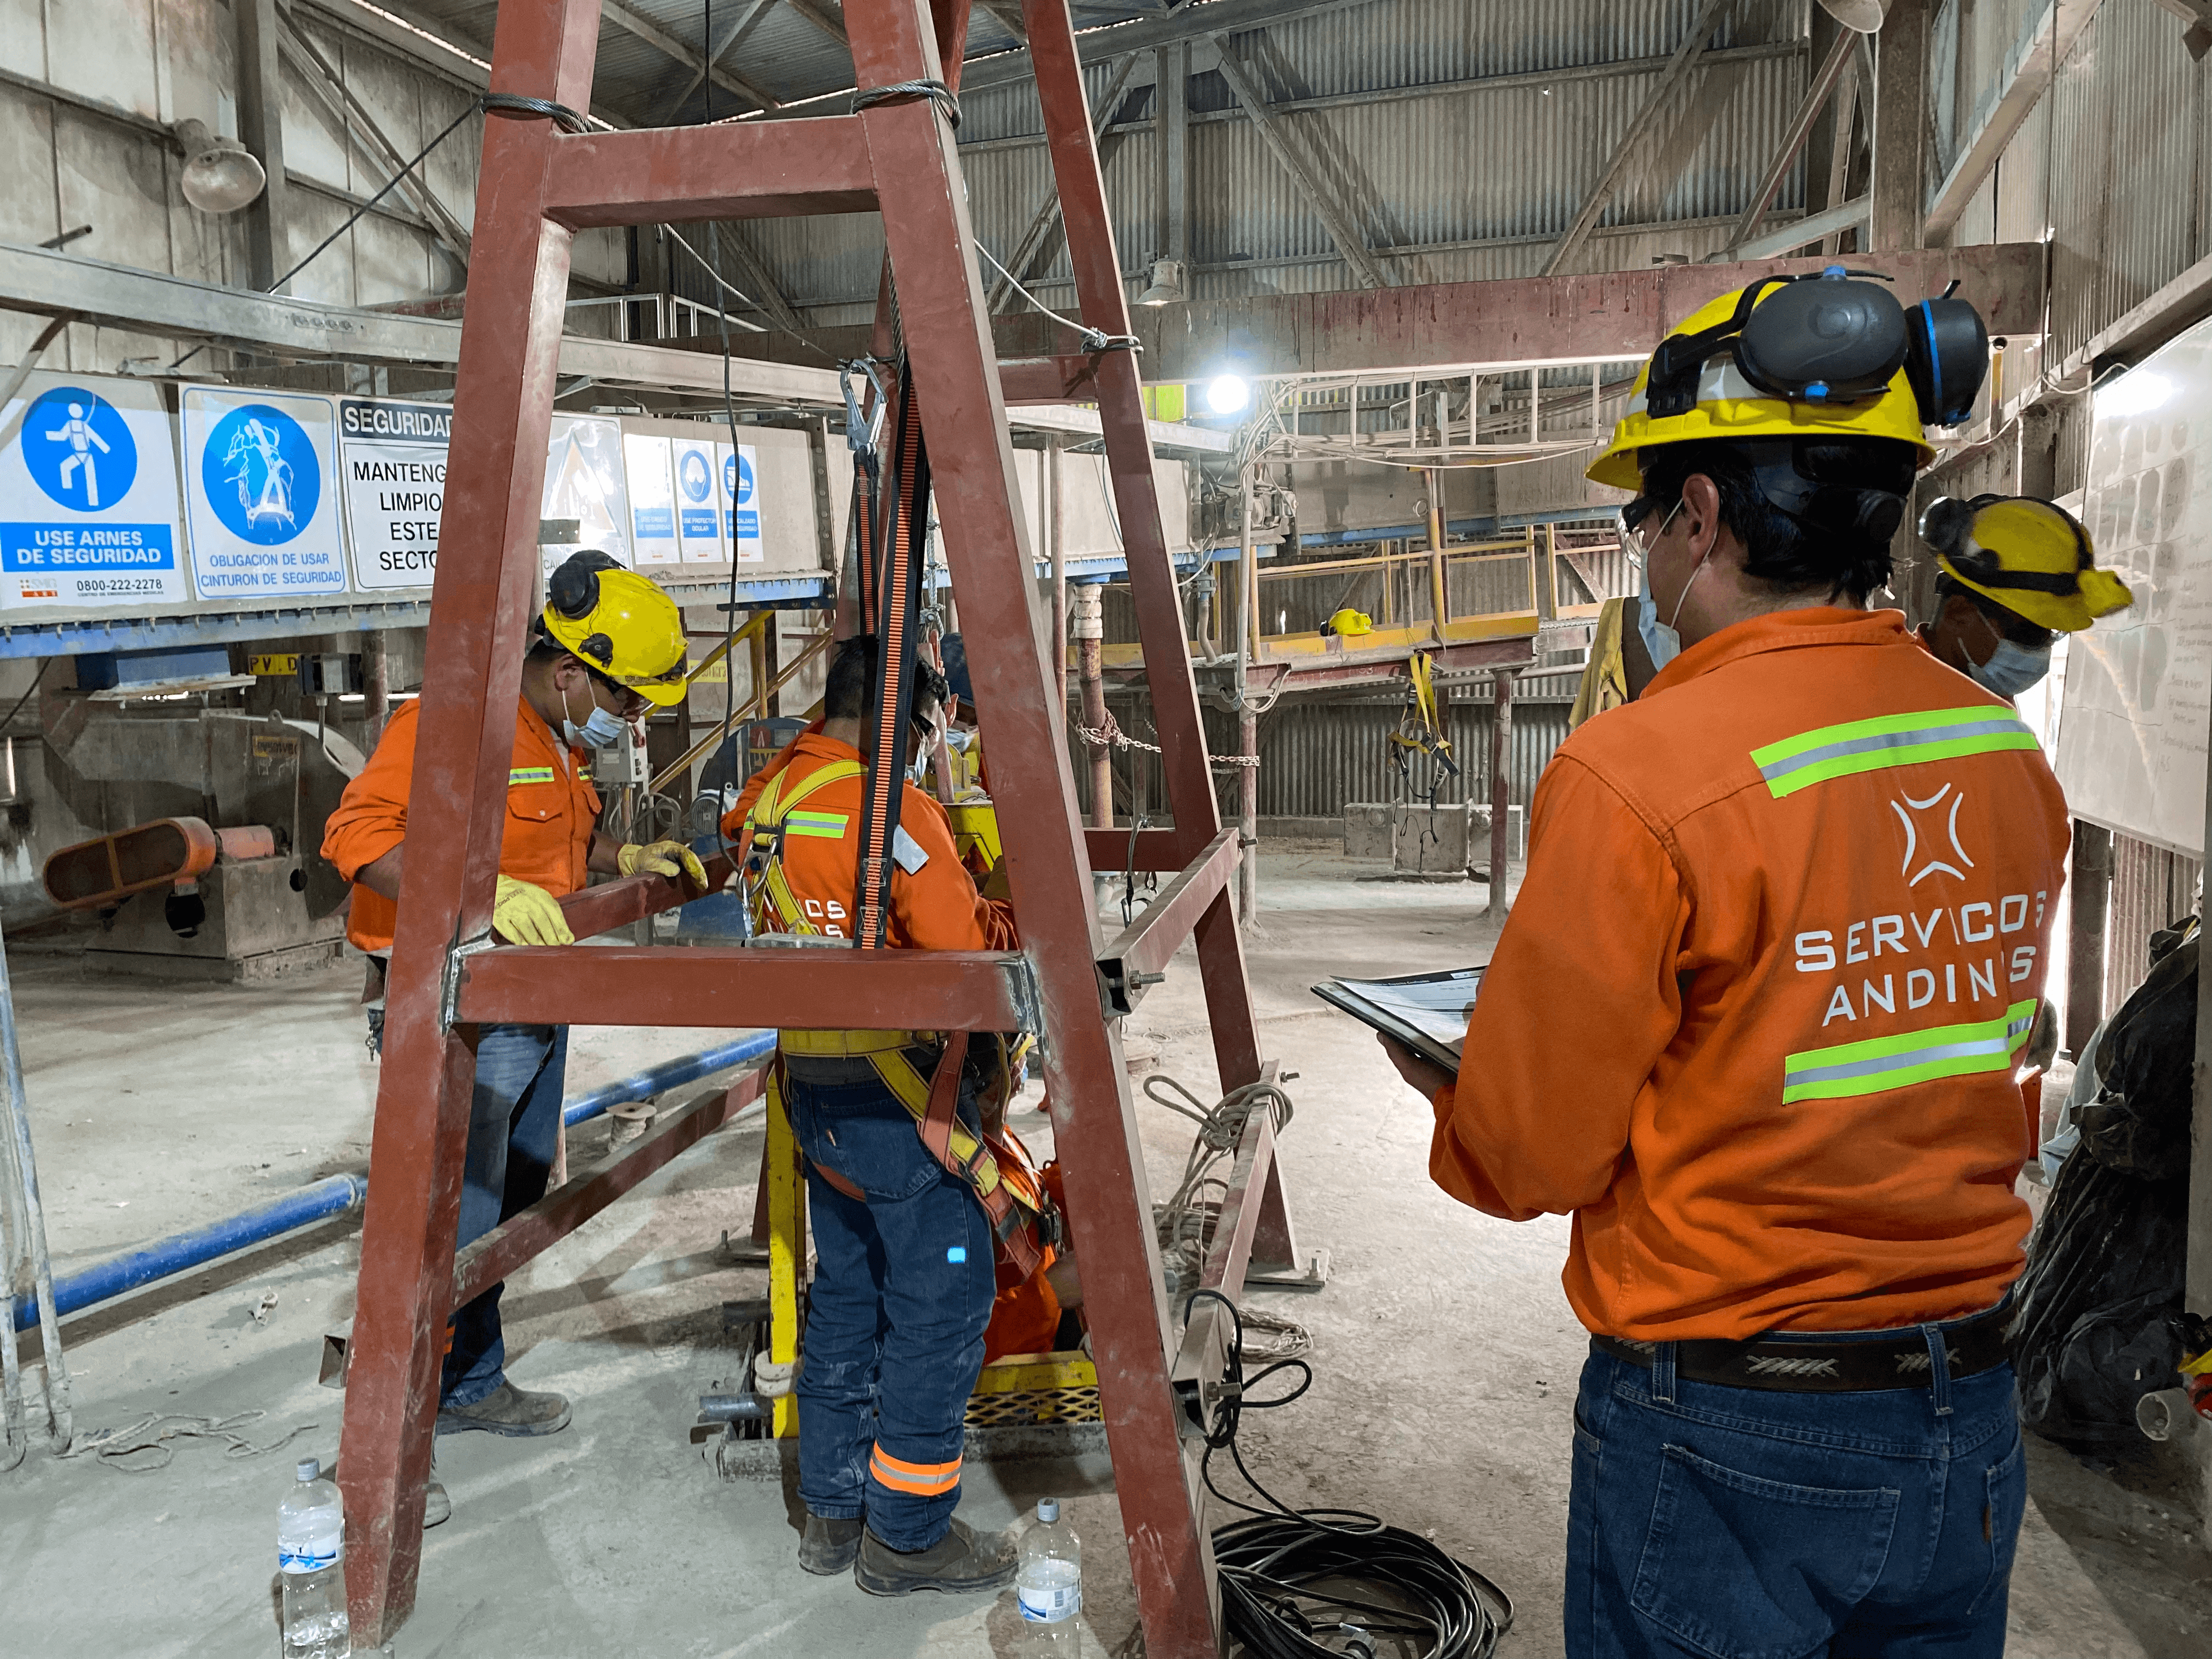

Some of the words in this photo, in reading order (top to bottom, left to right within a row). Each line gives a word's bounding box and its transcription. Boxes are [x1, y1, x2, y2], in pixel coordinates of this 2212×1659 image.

[354, 461, 446, 483] MANTENG
[380, 493, 442, 512] LIMPIO
[35, 530, 75, 547] USE
[79, 530, 143, 546] ARNES
[390, 521, 438, 540] ESTE
[17, 548, 45, 565] DE
[50, 548, 162, 564] SEGURIDAD
[210, 554, 278, 567] OBLIGACION
[282, 554, 297, 566] DE
[301, 553, 329, 565] USAR
[379, 550, 437, 570] SECTO
[77, 579, 162, 591] 0800-222-2278
[201, 574, 259, 586] CINTURON
[263, 573, 277, 585] DE
[283, 571, 342, 584] SEGURIDAD
[1821, 946, 2037, 1027] ANDINS
